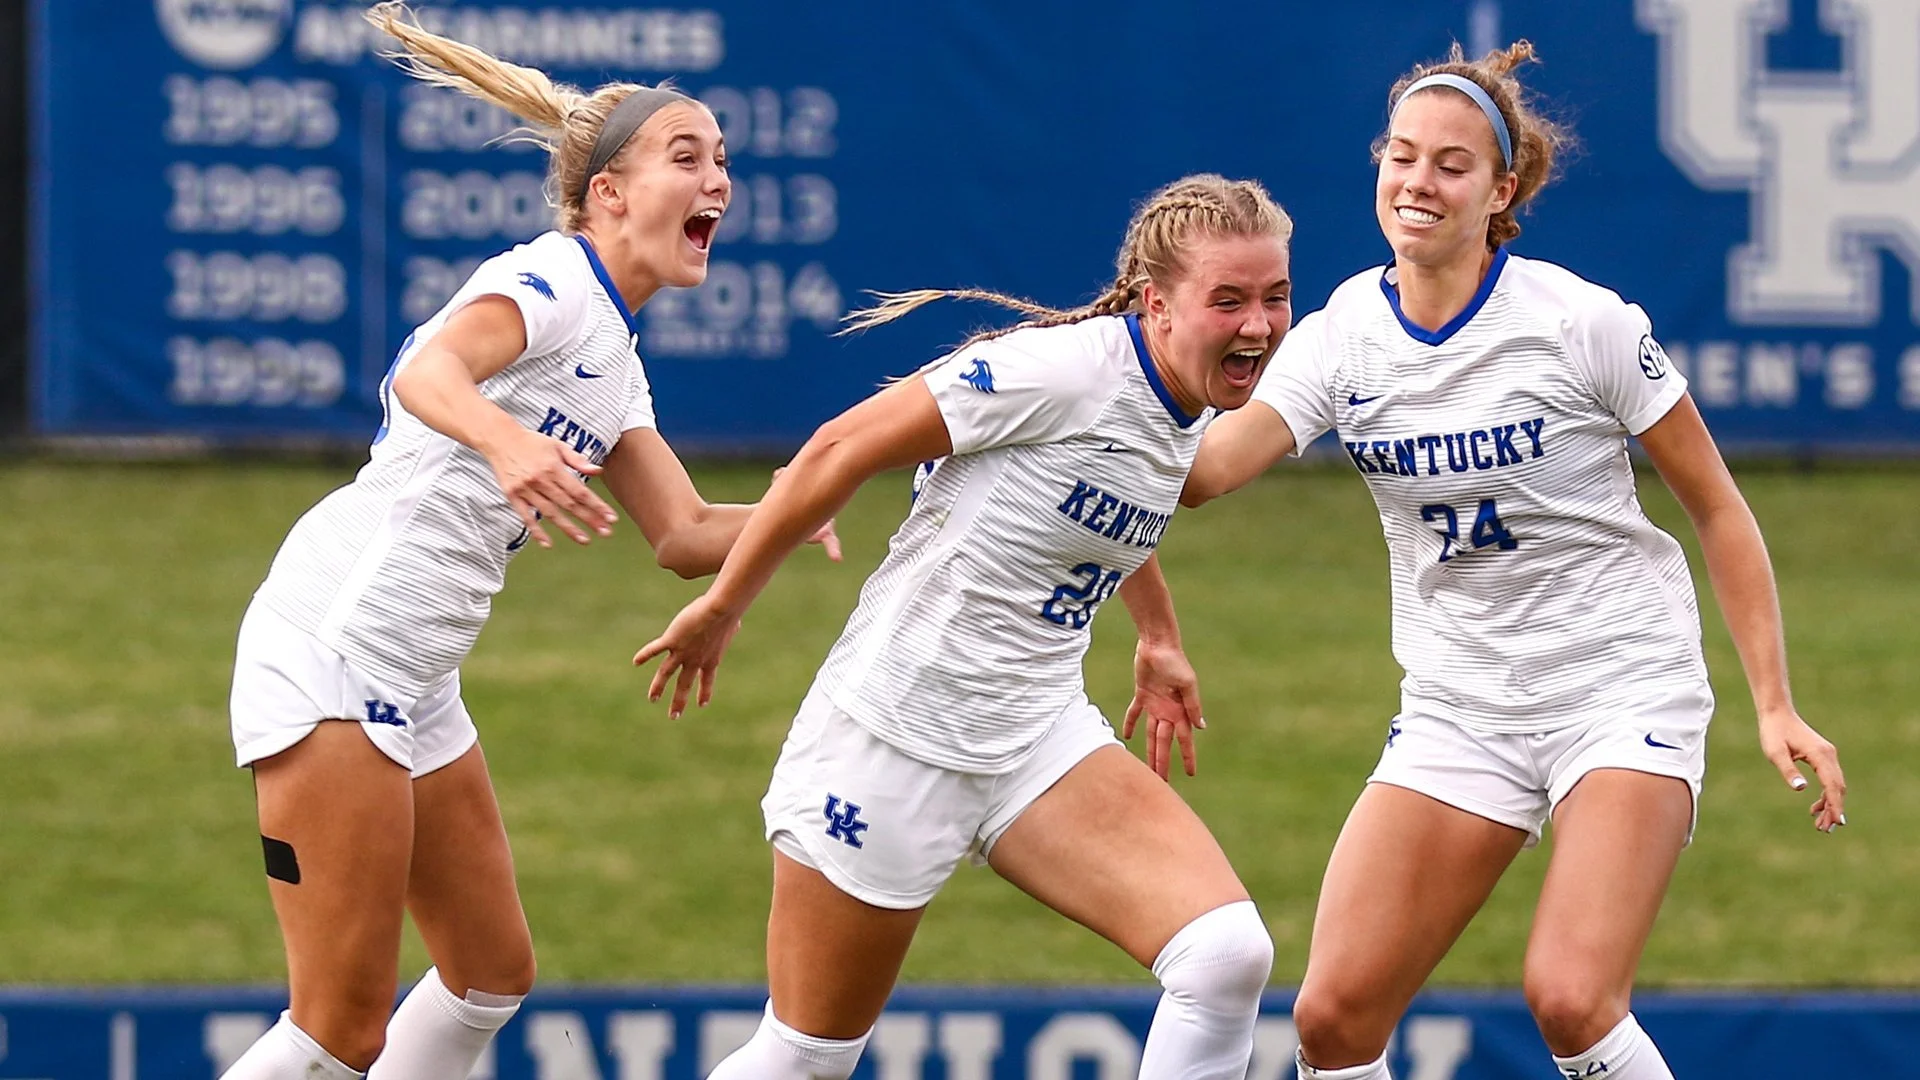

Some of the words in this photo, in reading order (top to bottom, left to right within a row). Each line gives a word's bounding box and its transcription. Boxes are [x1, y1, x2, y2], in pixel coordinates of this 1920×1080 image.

[1345, 416, 1545, 477] KENTUCKY
[1420, 498, 1519, 563] 24
[823, 792, 869, 850] UK
